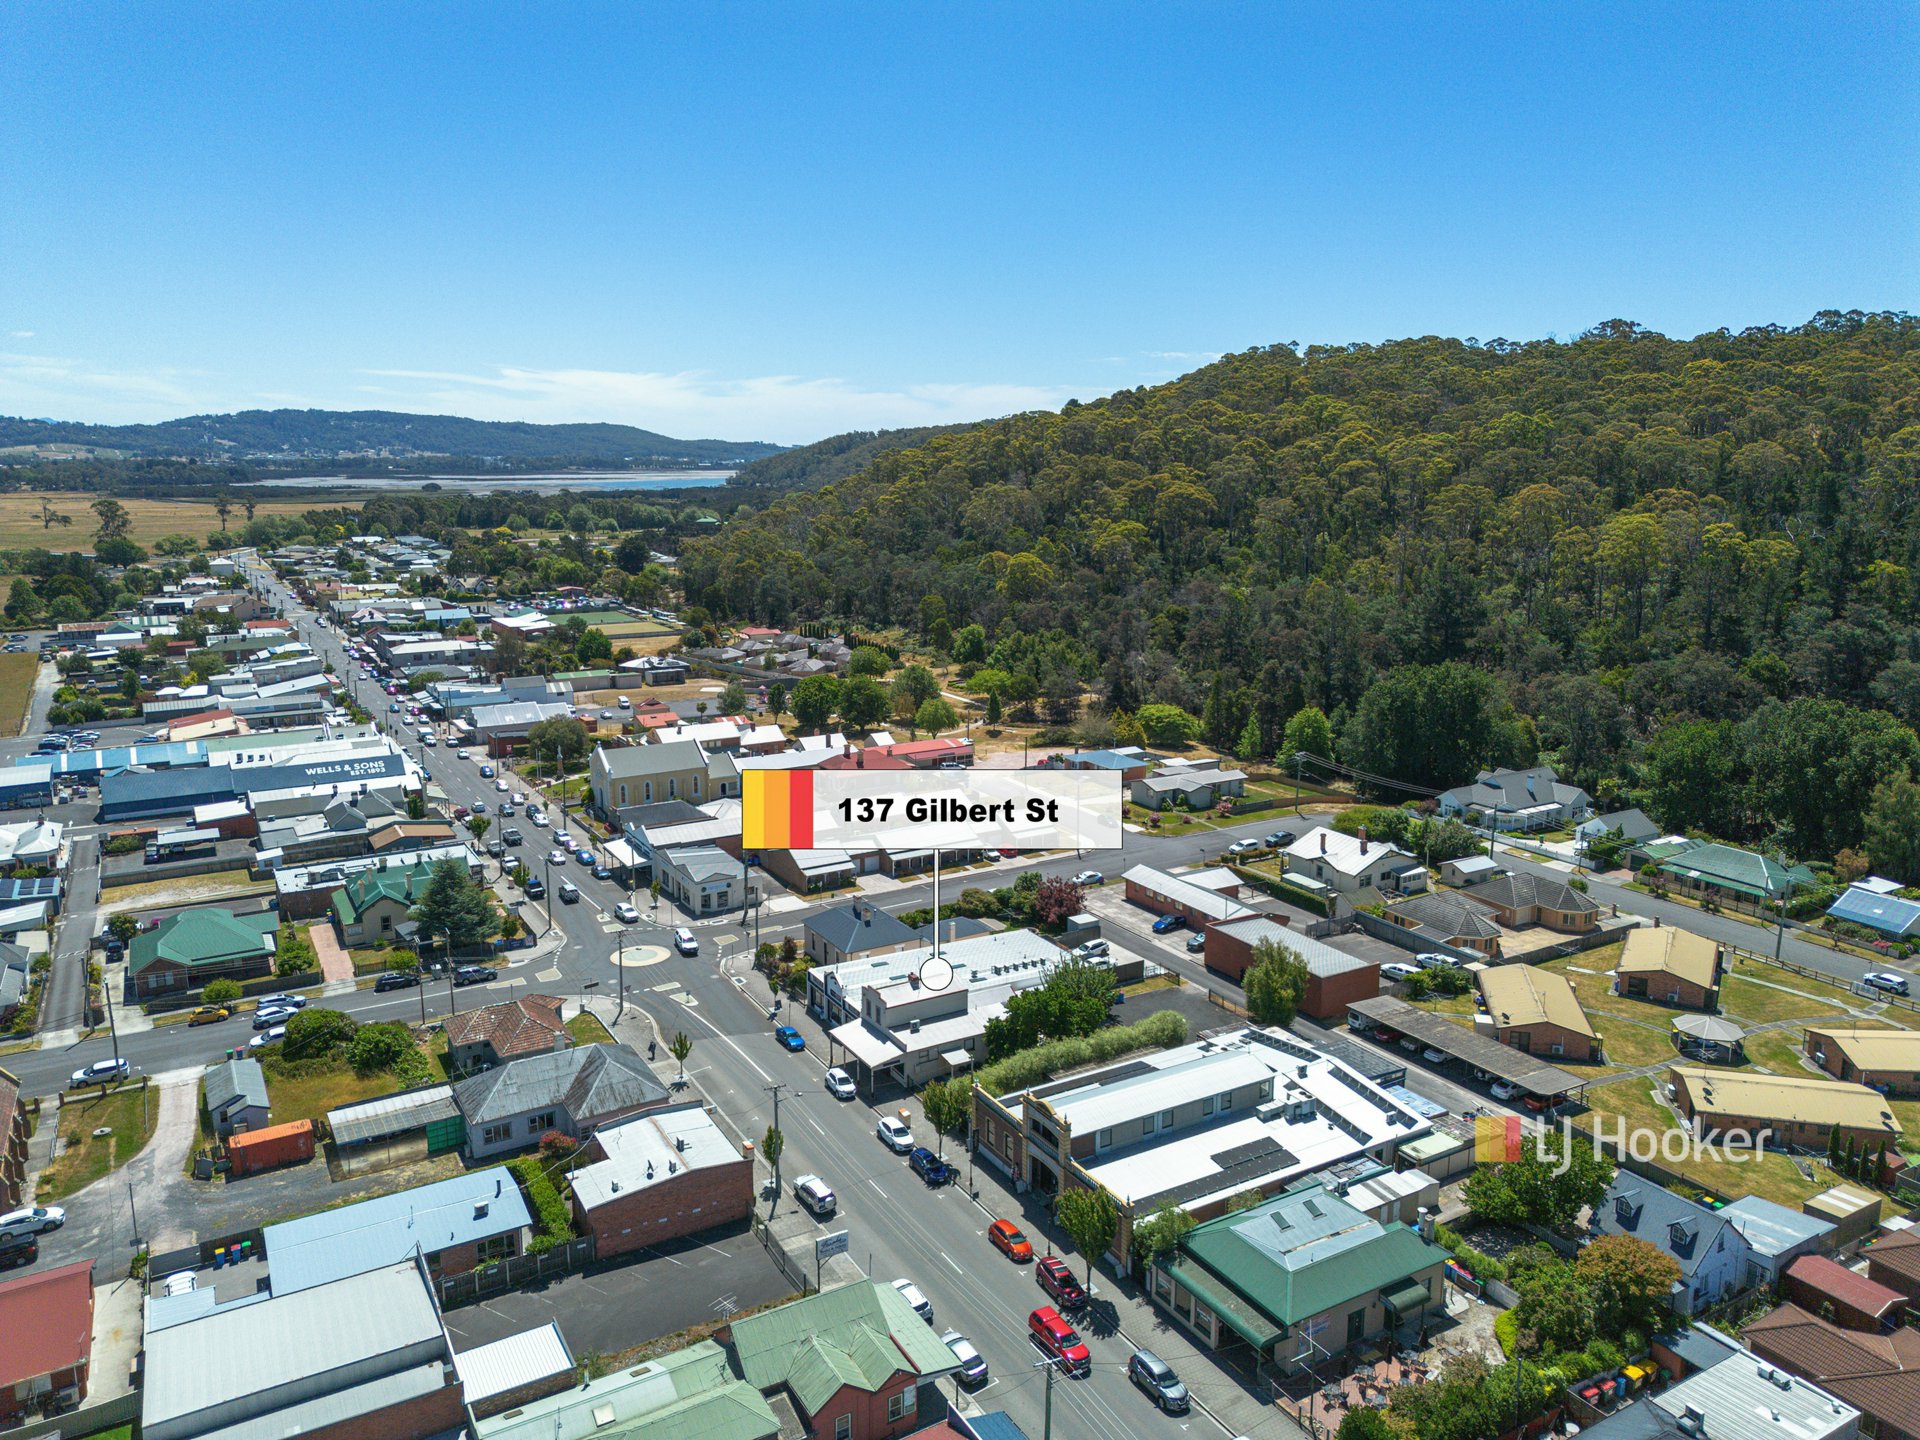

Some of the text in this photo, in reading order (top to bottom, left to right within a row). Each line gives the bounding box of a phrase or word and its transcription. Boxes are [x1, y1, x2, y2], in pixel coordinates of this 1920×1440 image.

[305, 765, 341, 776] WELLS
[353, 760, 385, 770] SONS
[367, 767, 386, 775] 1893
